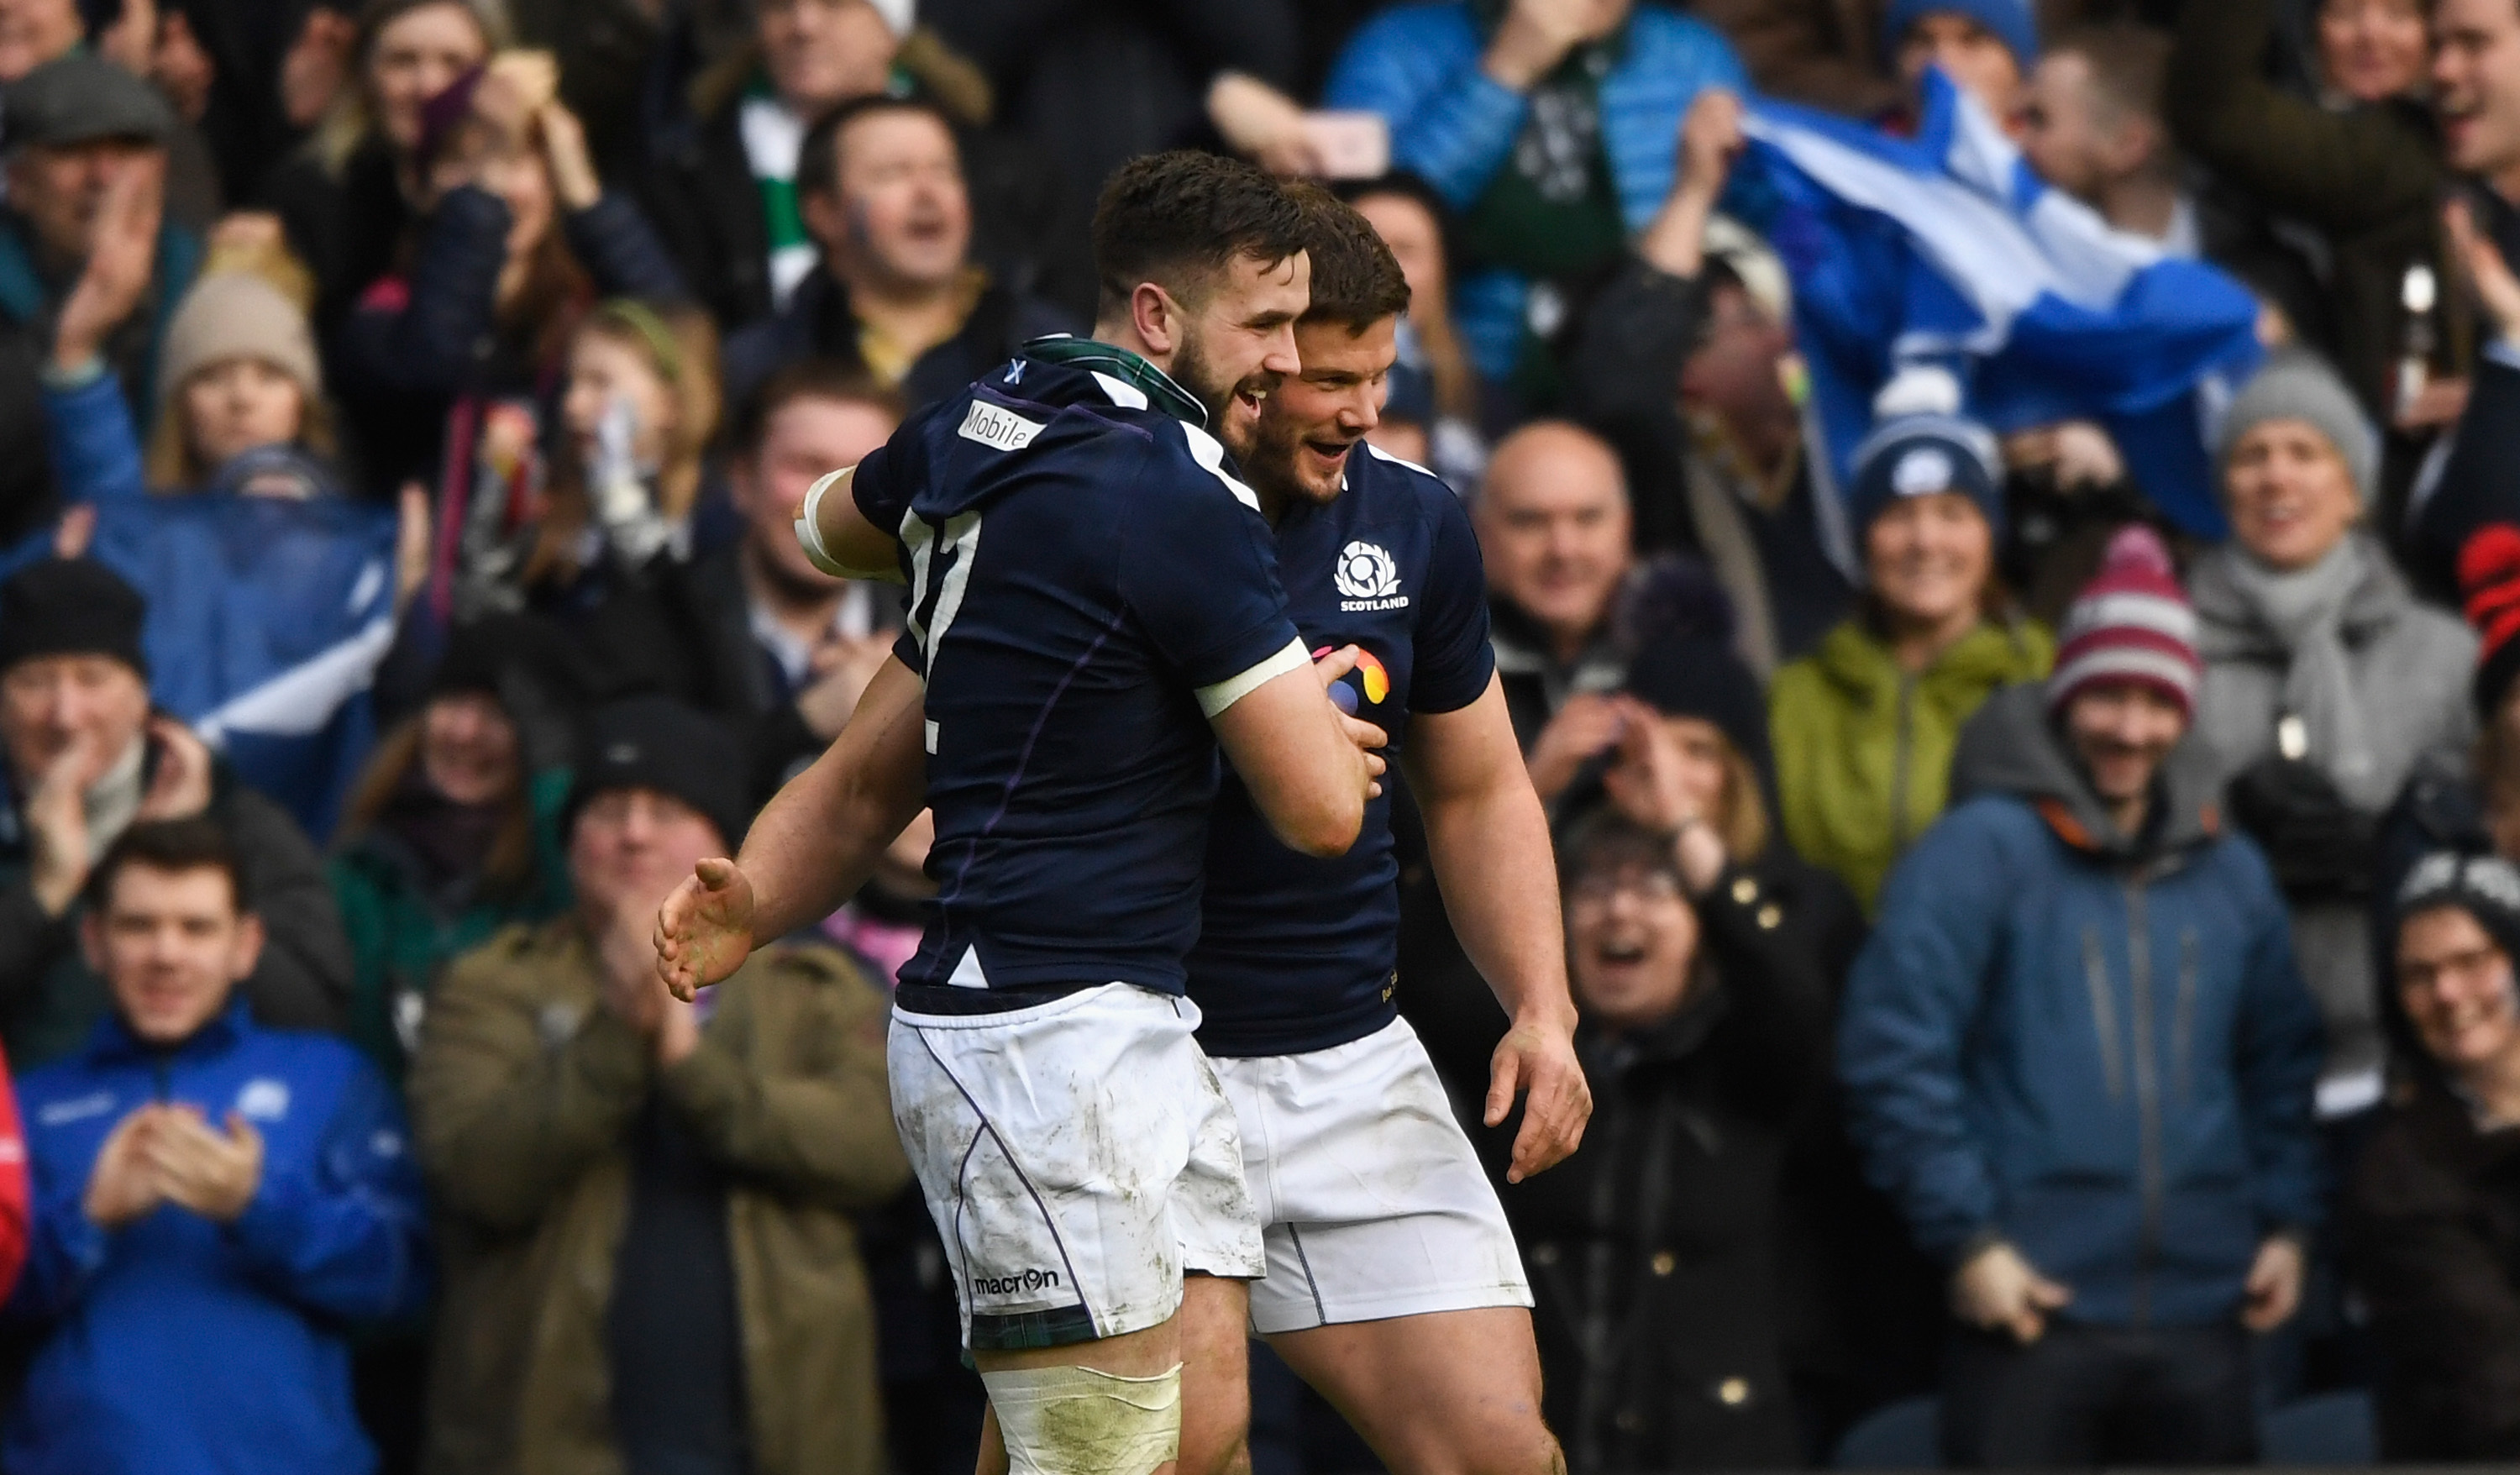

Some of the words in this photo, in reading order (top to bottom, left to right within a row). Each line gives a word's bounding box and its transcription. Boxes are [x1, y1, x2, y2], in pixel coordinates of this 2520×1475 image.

[965, 405, 1026, 446] Mobile
[1340, 596, 1410, 612] SCOTLAND
[974, 1268, 1059, 1294] macron
